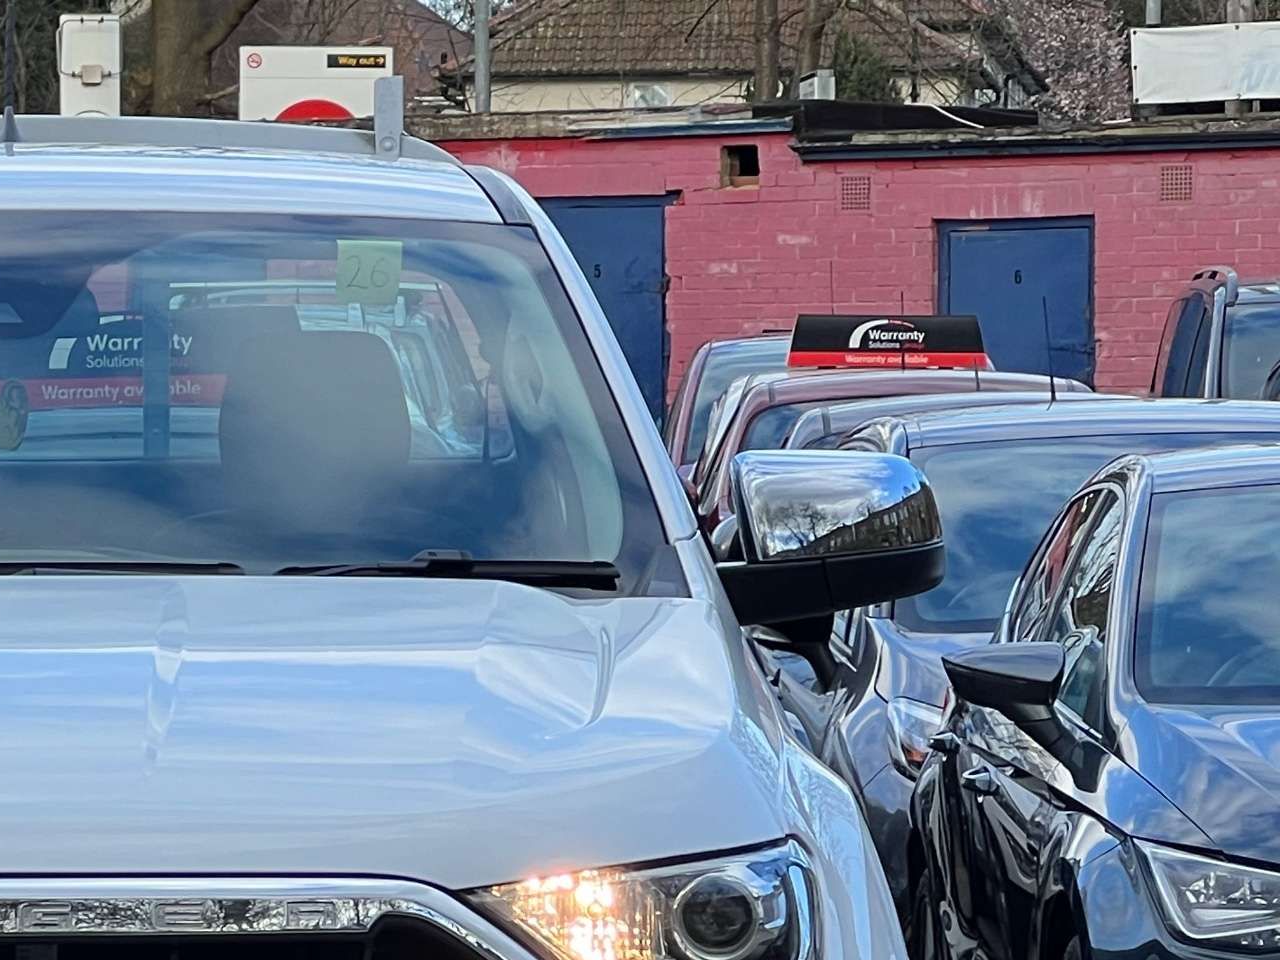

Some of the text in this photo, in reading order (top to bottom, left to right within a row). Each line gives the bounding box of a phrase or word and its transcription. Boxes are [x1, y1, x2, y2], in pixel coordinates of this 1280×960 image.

[337, 56, 357, 67] Way
[345, 255, 391, 288] 26
[594, 264, 601, 278] 5
[1014, 269, 1022, 285] 6
[86, 333, 192, 355] Warrty
[869, 330, 925, 343] Warranty
[887, 353, 928, 364] avalable
[41, 380, 201, 401] Warranty avable
